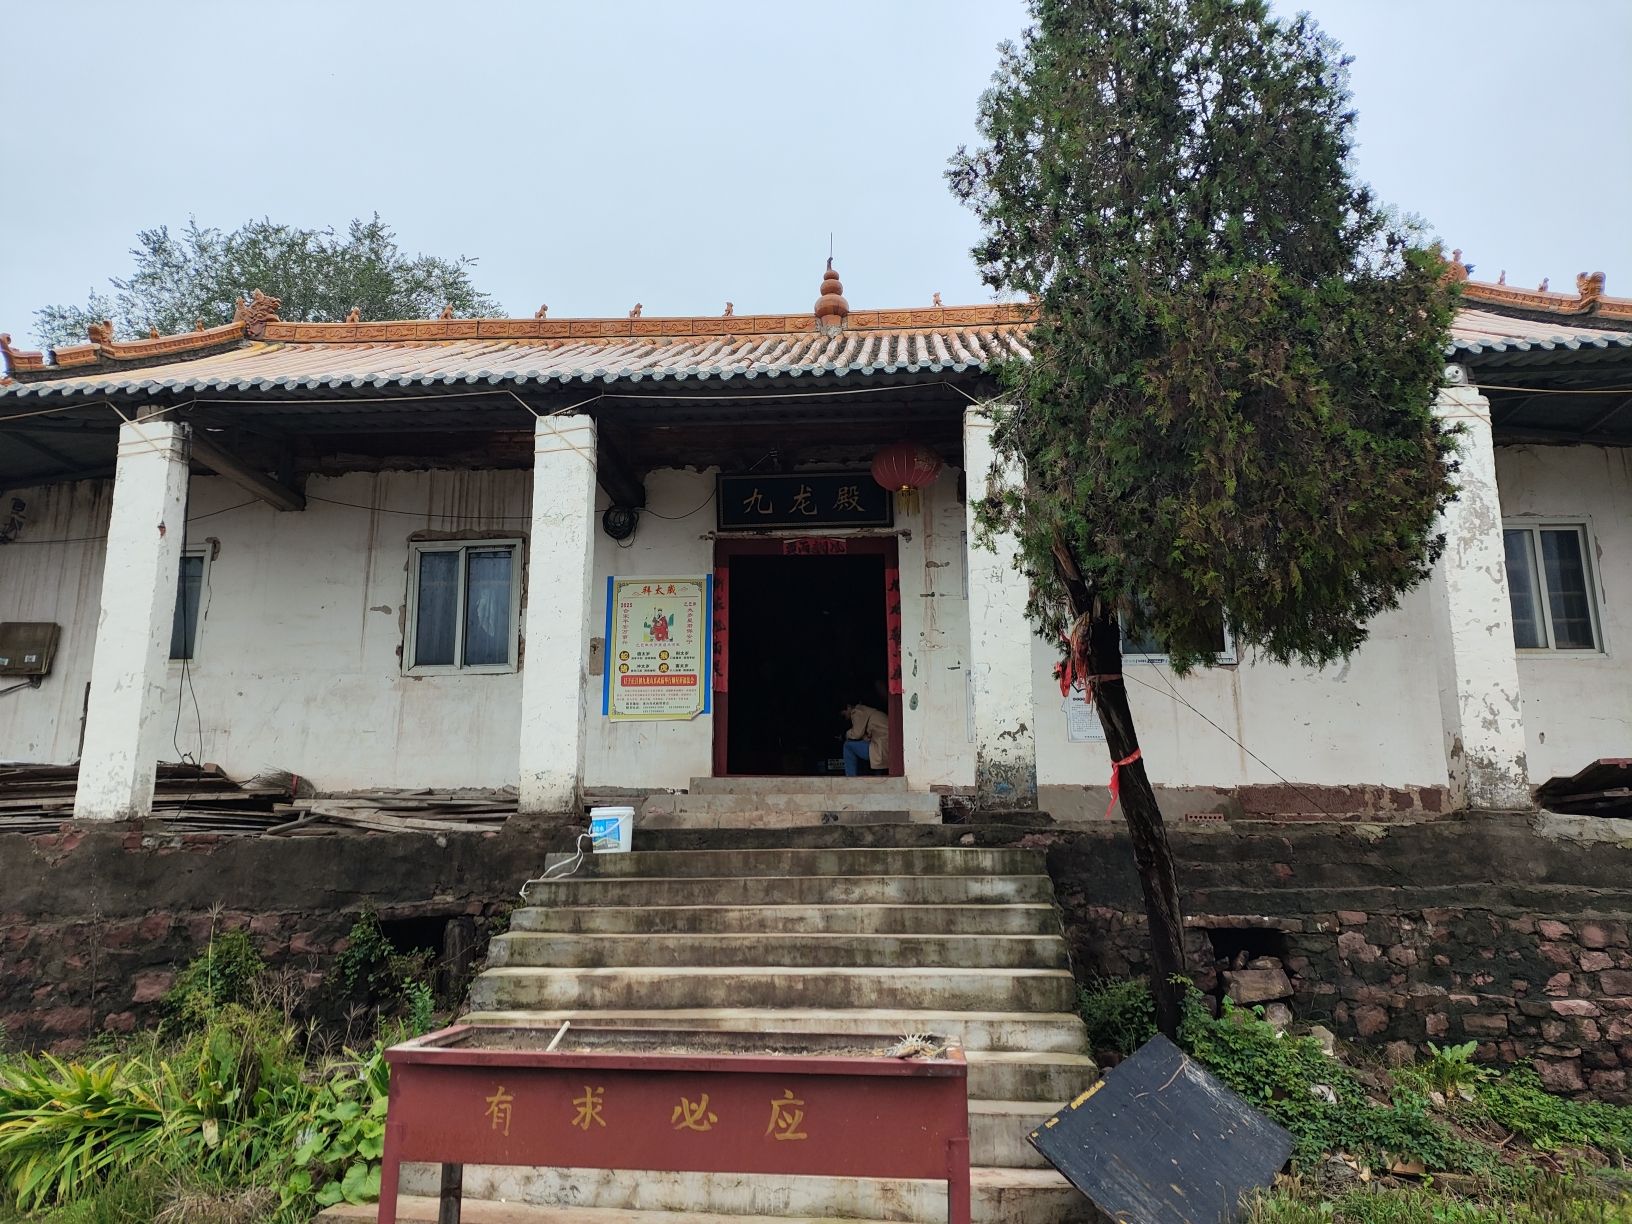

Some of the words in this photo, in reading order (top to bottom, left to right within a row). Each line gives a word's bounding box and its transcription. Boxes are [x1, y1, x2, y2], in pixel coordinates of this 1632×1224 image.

[743, 484, 865, 515] 九龙殿
[485, 1085, 808, 1141] 有求必应
